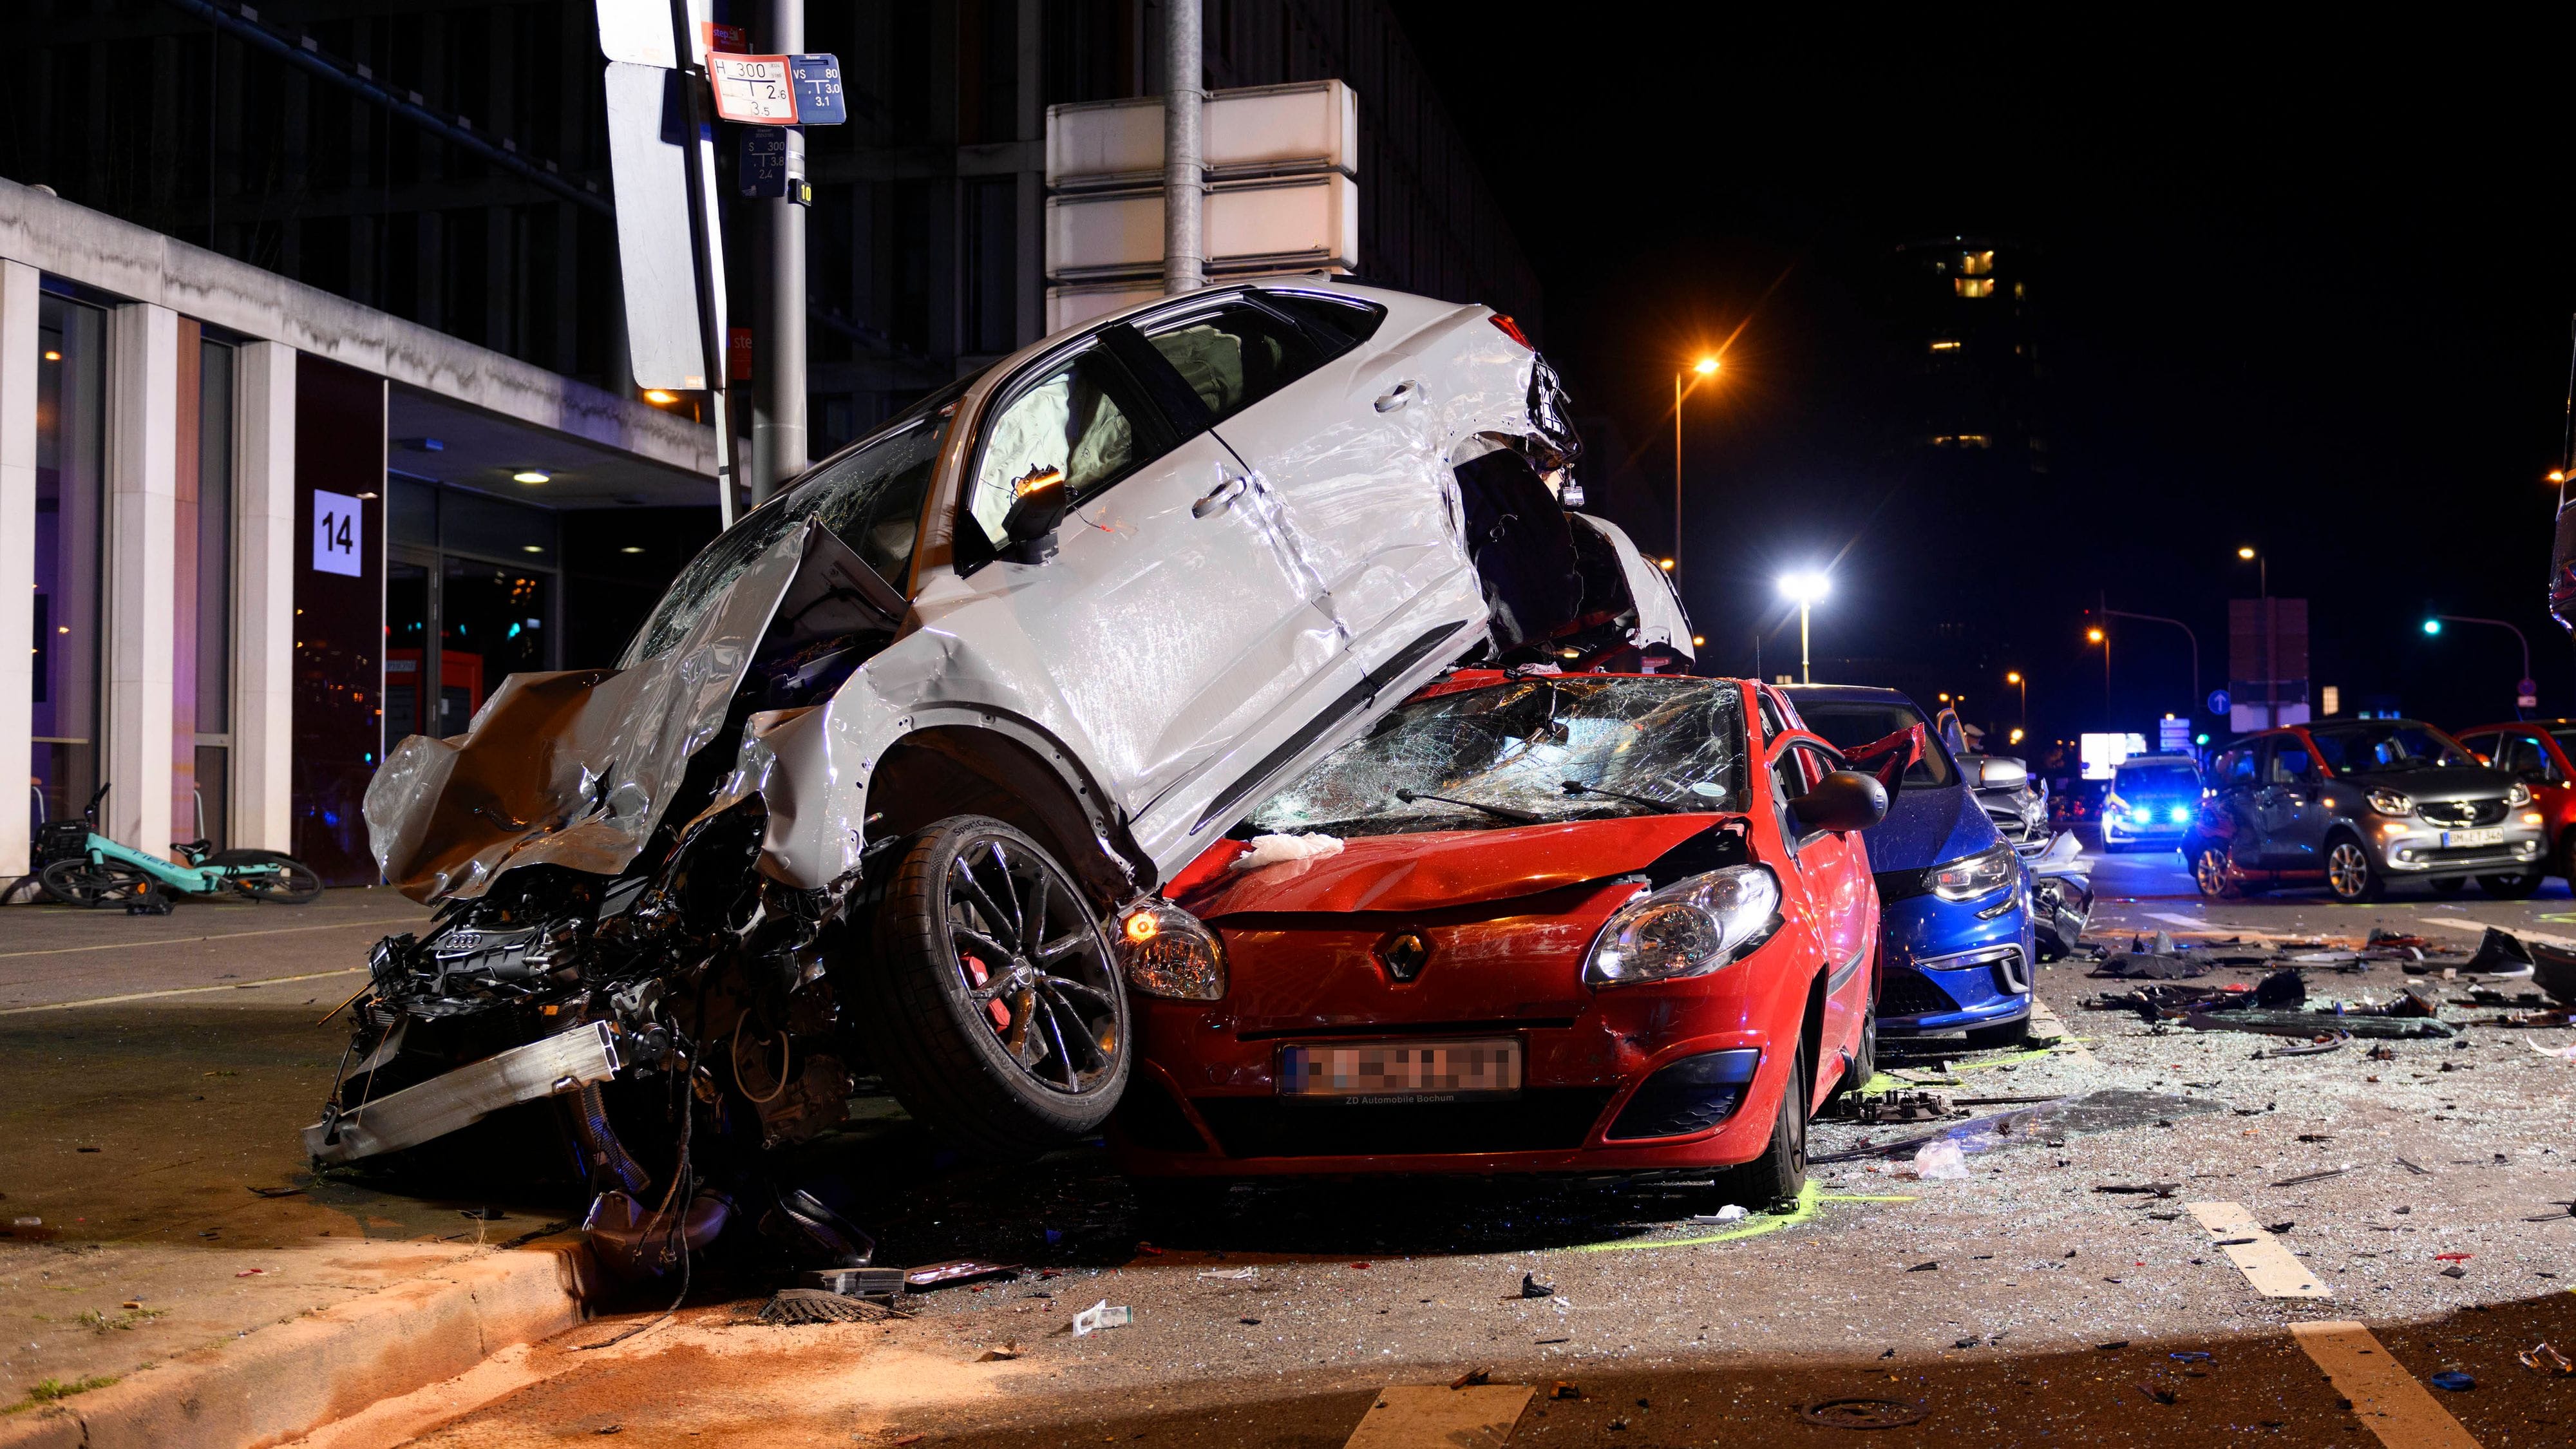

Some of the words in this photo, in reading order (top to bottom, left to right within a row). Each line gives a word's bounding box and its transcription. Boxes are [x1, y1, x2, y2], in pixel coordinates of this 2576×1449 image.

[715, 60, 726, 75] H
[736, 62, 766, 78] 300
[793, 69, 806, 79] VS
[825, 68, 838, 79] 80
[748, 142, 755, 152] S
[767, 142, 785, 151] 300
[800, 184, 811, 202] 10
[734, 335, 752, 348] ste
[323, 511, 353, 554] 14
[1346, 1096, 1359, 1105] ZD
[1361, 1095, 1414, 1104] Automobile
[1417, 1094, 1454, 1103] Bochum
